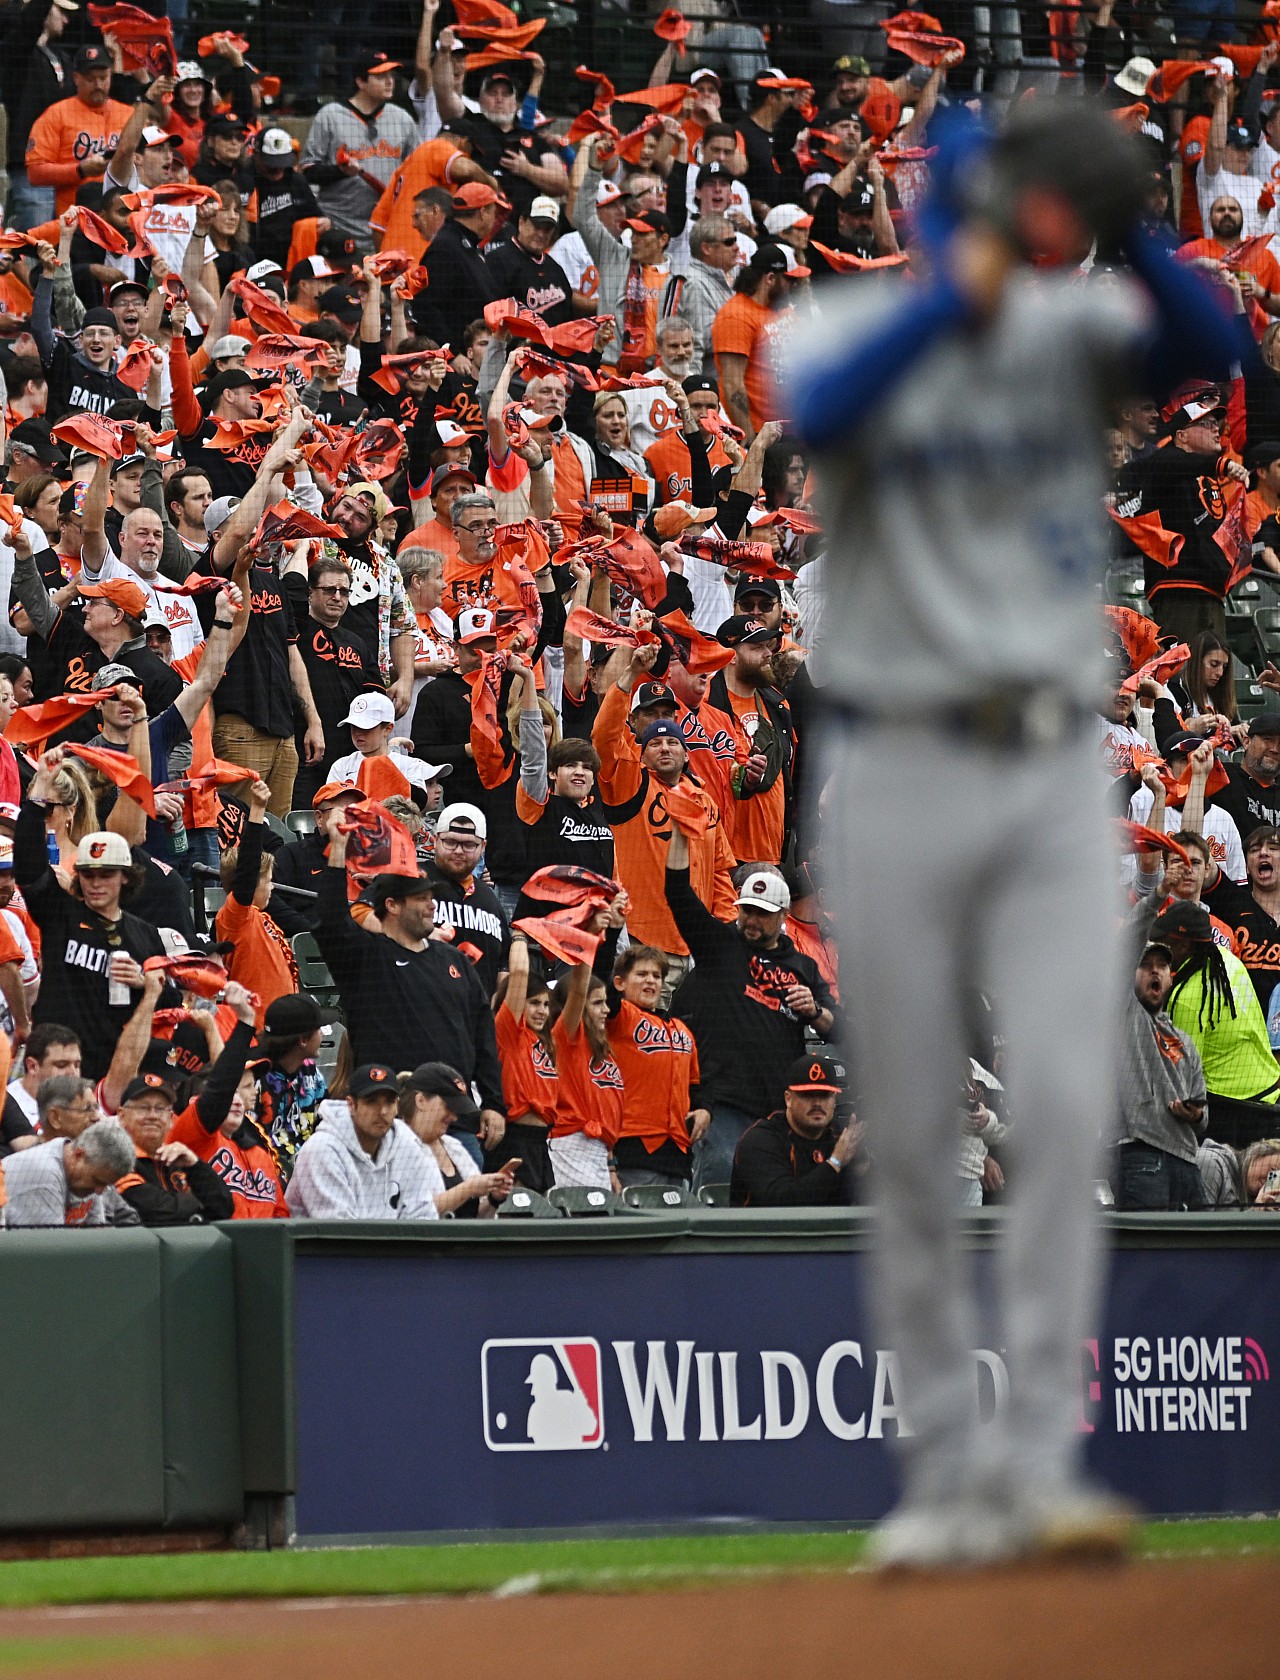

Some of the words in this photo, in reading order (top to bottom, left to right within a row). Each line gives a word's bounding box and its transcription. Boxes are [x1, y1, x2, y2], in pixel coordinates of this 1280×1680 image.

[74, 132, 120, 160] Orio
[68, 386, 117, 413] BALTIM
[166, 605, 194, 624] oles
[1114, 1338, 1151, 1382] 5G
[1159, 1337, 1243, 1381] HOME
[612, 1340, 1011, 1442] WILDCAD
[1115, 1386, 1253, 1433] INTERNET
